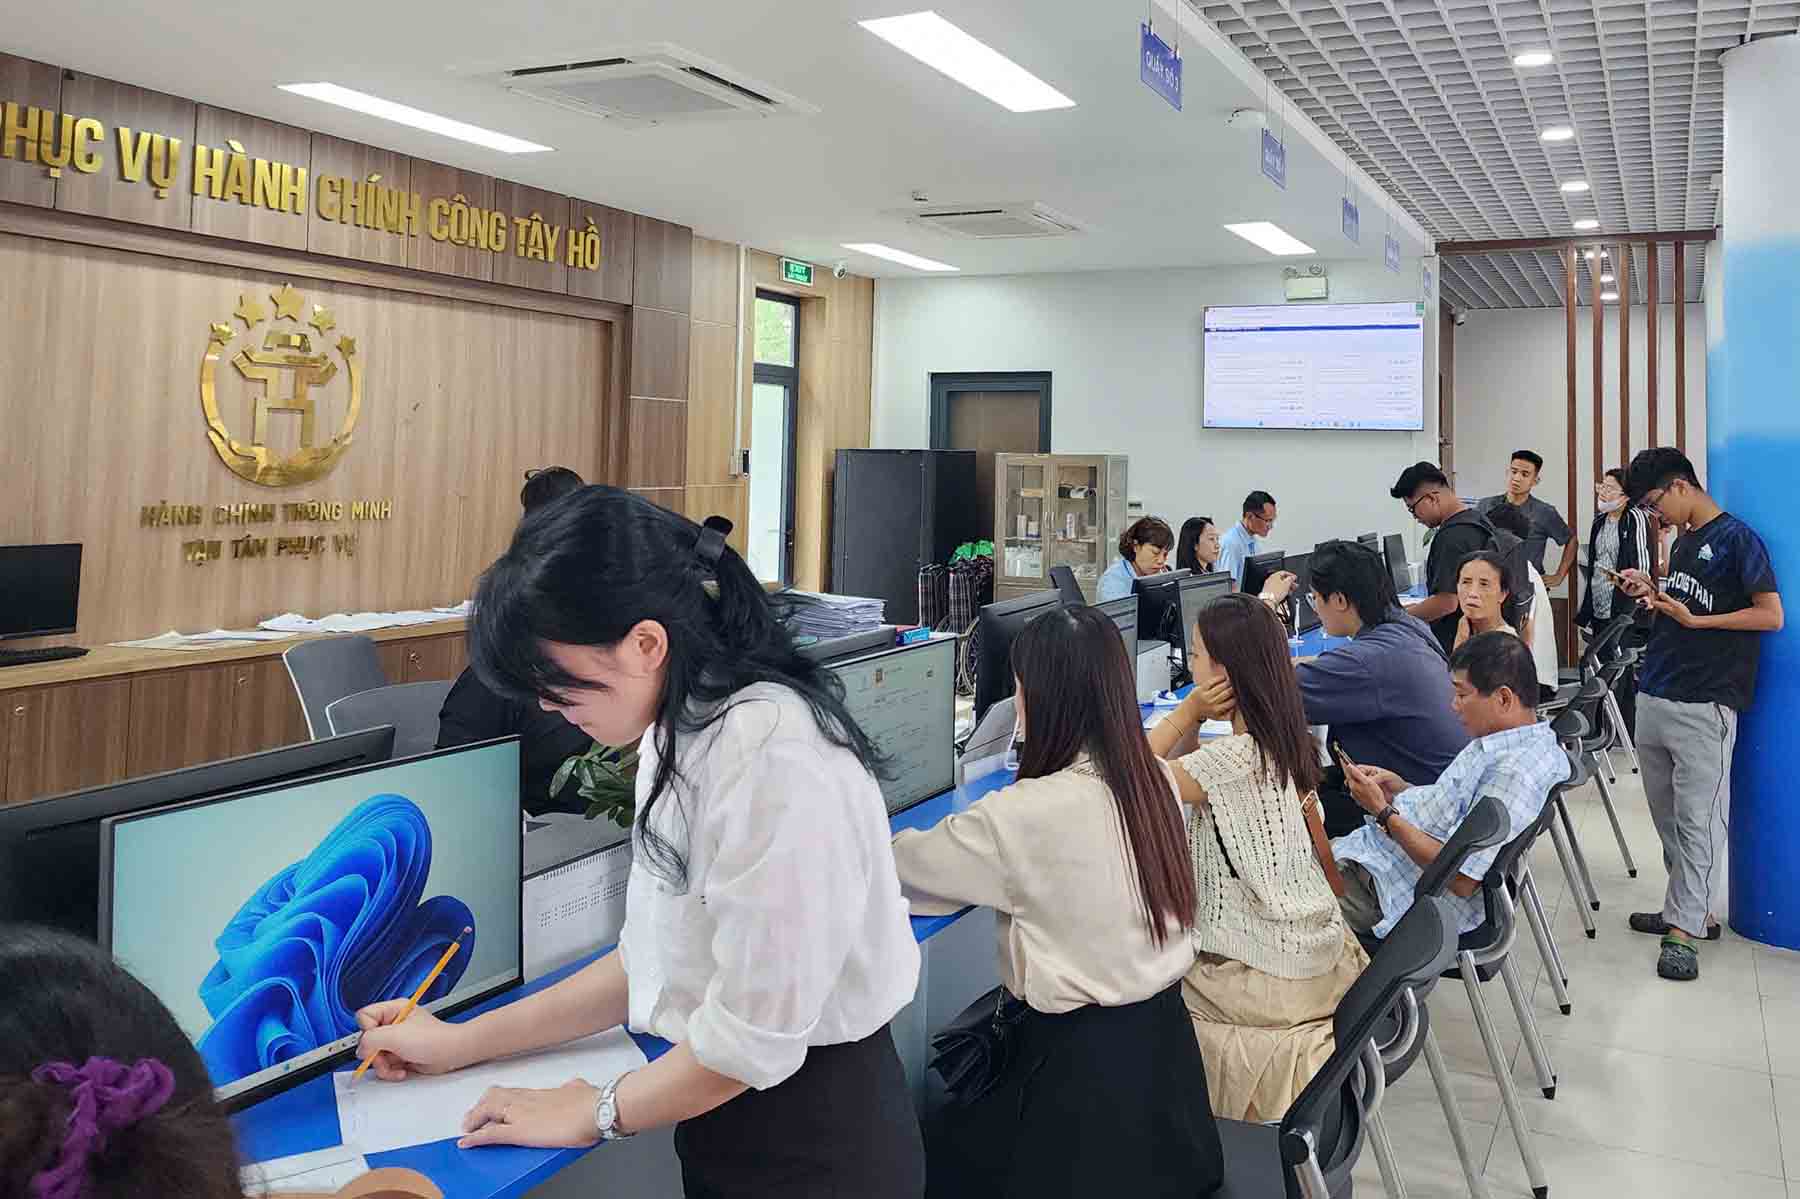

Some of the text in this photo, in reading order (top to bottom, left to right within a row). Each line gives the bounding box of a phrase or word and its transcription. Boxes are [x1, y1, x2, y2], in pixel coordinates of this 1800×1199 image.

[0, 102, 601, 272] HỤC VỤ HÀNH CHÍNH CÔNG TÂY HỒ
[139, 498, 393, 529] HÀNH CHÍNH THÔNG MINH
[181, 538, 224, 567] TẬN
[230, 533, 269, 560] TÂM
[274, 533, 326, 561] PHỤC
